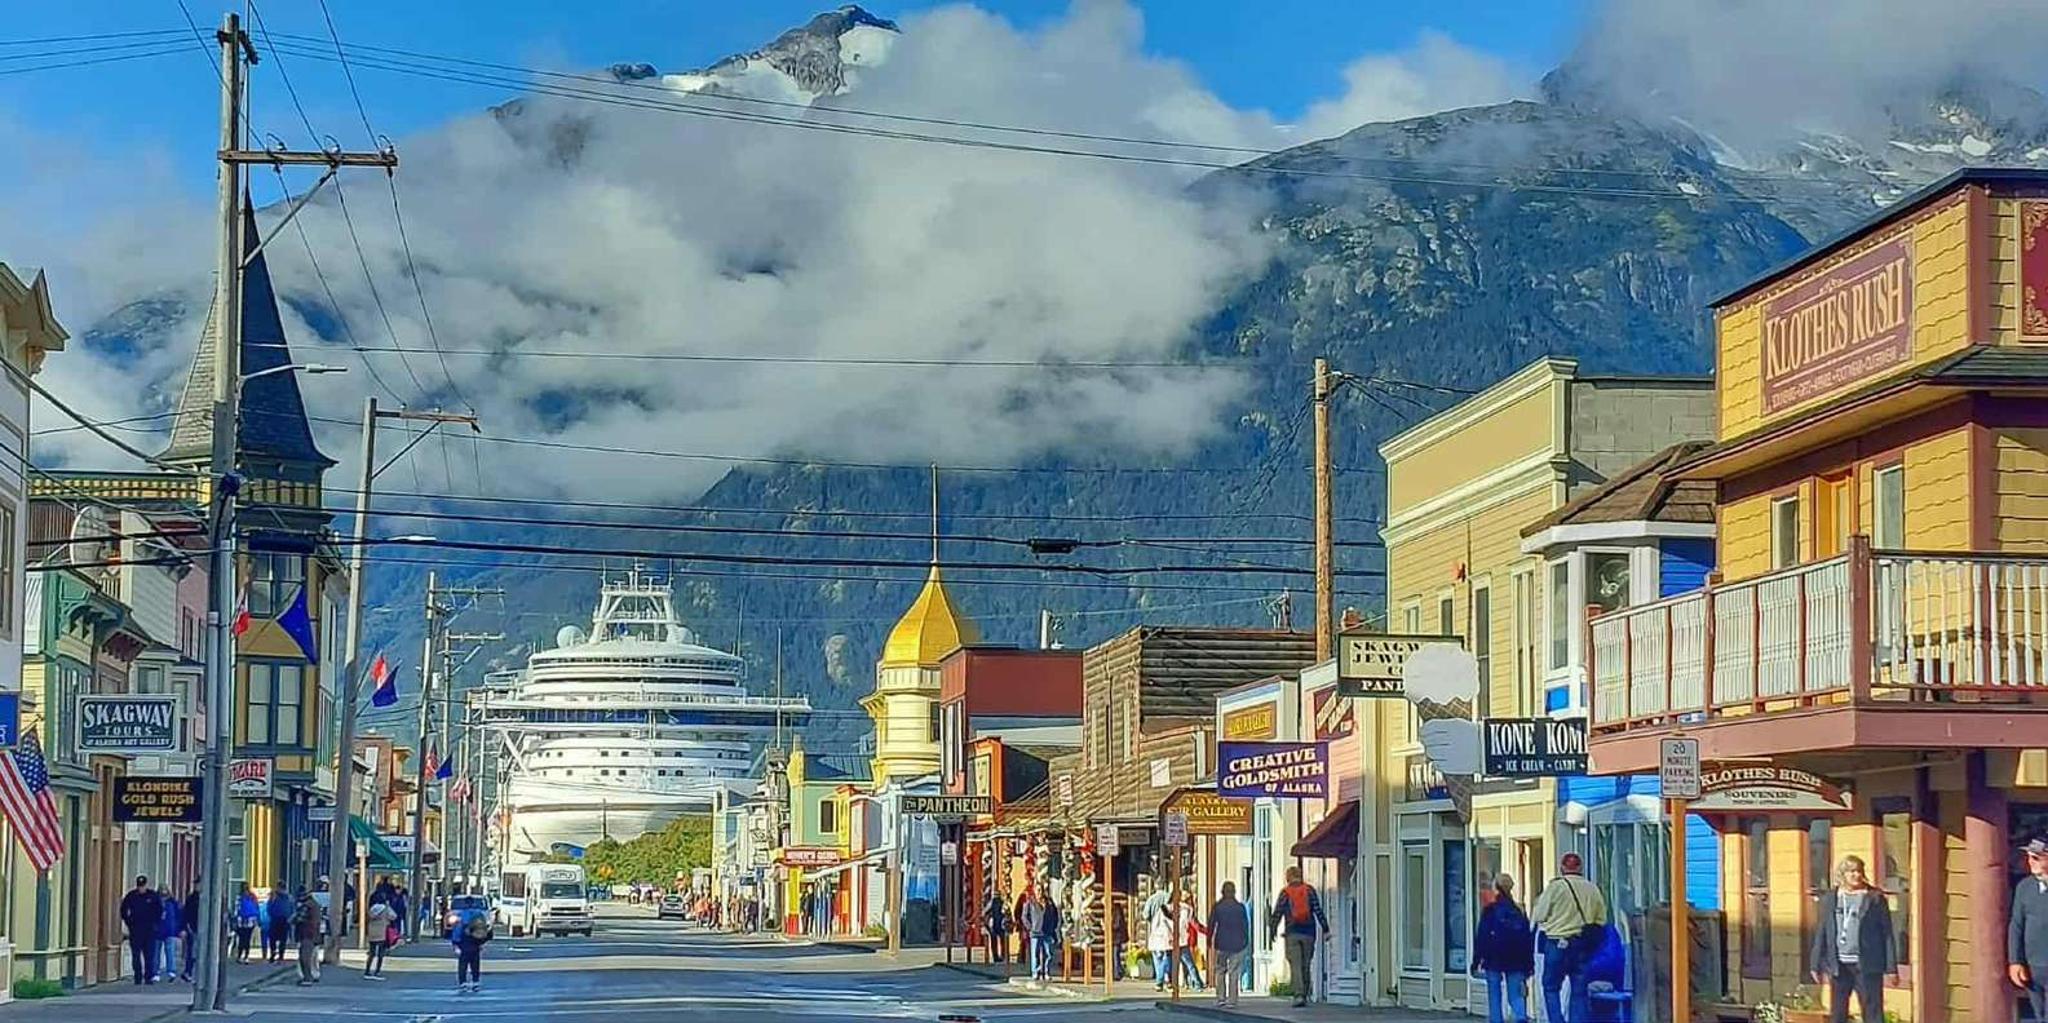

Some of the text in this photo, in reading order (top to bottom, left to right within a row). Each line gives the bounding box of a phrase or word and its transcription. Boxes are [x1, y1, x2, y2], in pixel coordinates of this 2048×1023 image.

[1766, 291, 1849, 380] KLOTHES
[1852, 258, 1906, 344] RUSH
[83, 704, 173, 729] SKAGWAY
[105, 726, 152, 737] TOURS
[1490, 722, 1536, 756] KONE
[1672, 743, 1686, 754] 20
[1229, 748, 1316, 773] CREATIVE
[1506, 759, 1576, 771] ICE CREAM CANDY
[1222, 762, 1325, 789] GOLDSMITH
[1700, 767, 1822, 786] KLOTHES RUSH
[127, 782, 190, 792] KLONDIKE
[1265, 783, 1322, 793] OF ALASKA
[121, 795, 195, 804] GOLD RUSH
[1724, 791, 1797, 799] SOUVENIRS
[918, 798, 989, 812] PANTHEON
[1186, 797, 1229, 805] ALASKA
[133, 806, 184, 816] JEWELS
[1193, 806, 1247, 817] GALLERY
